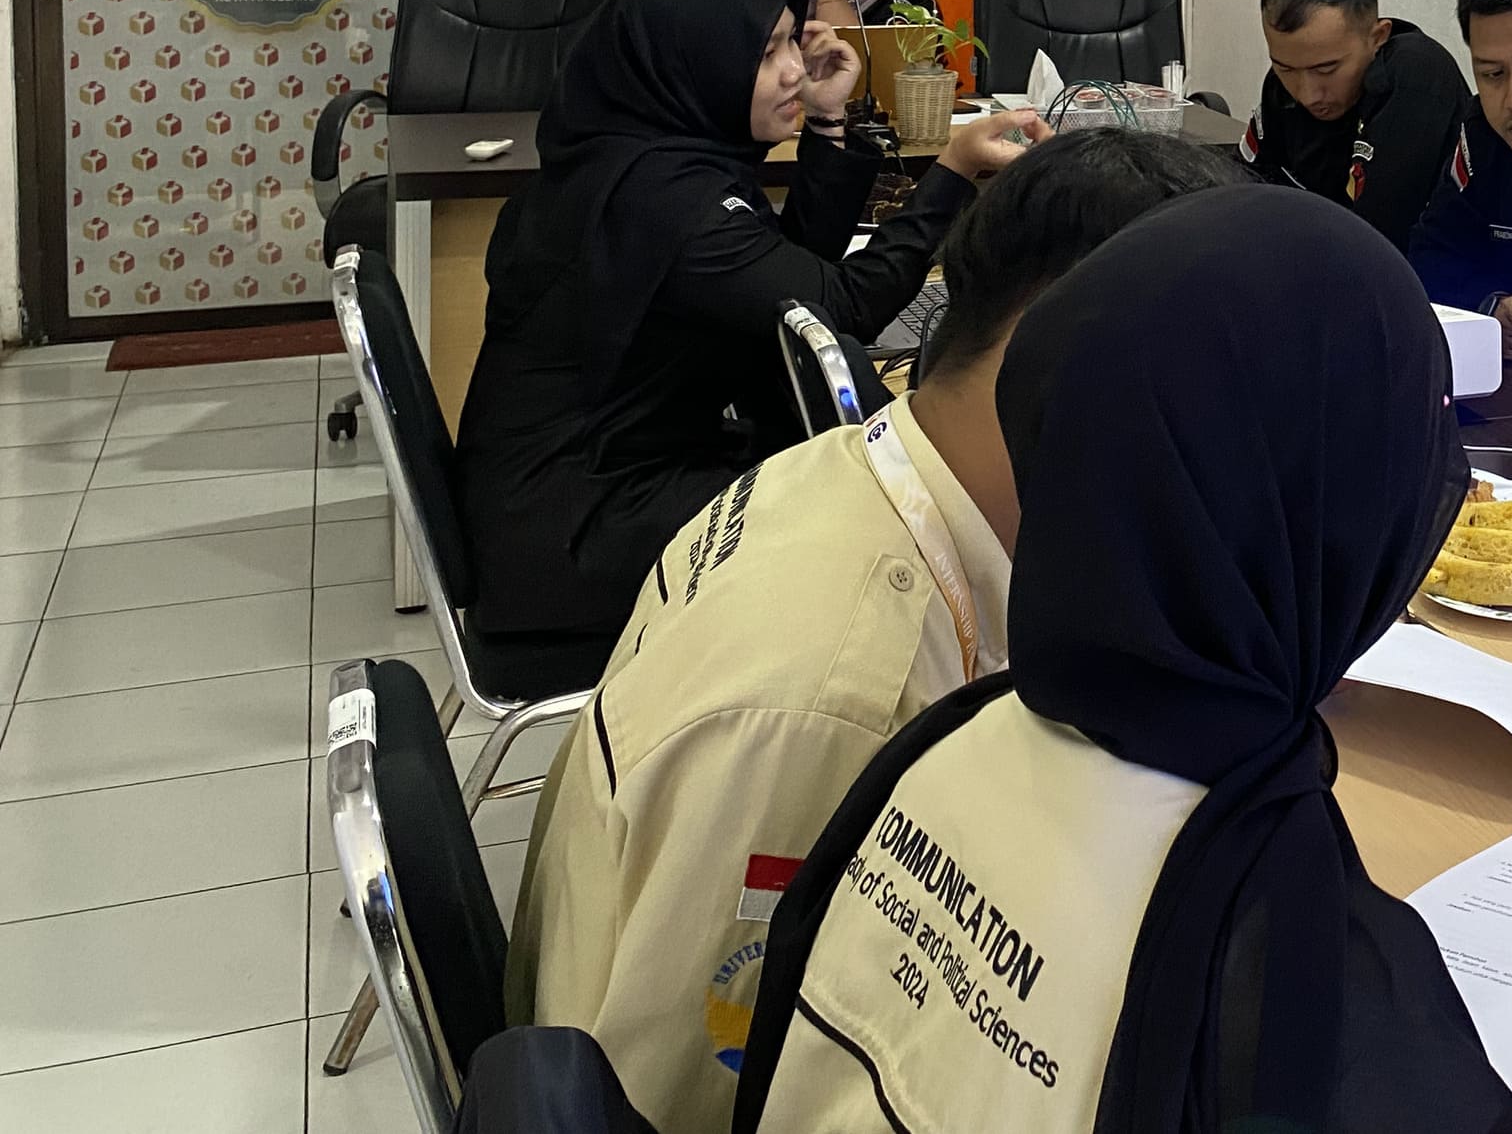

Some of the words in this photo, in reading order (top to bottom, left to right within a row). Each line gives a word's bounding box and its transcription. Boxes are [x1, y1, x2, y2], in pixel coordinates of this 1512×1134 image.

[712, 941, 765, 985] UNIVER
[876, 806, 1045, 1002] COMMUNICATION
[859, 872, 885, 900] of
[875, 881, 920, 937] Social
[916, 923, 945, 963] and
[937, 940, 978, 1010] Political
[969, 989, 1059, 1088] Sciences
[890, 953, 929, 1010] 2024
